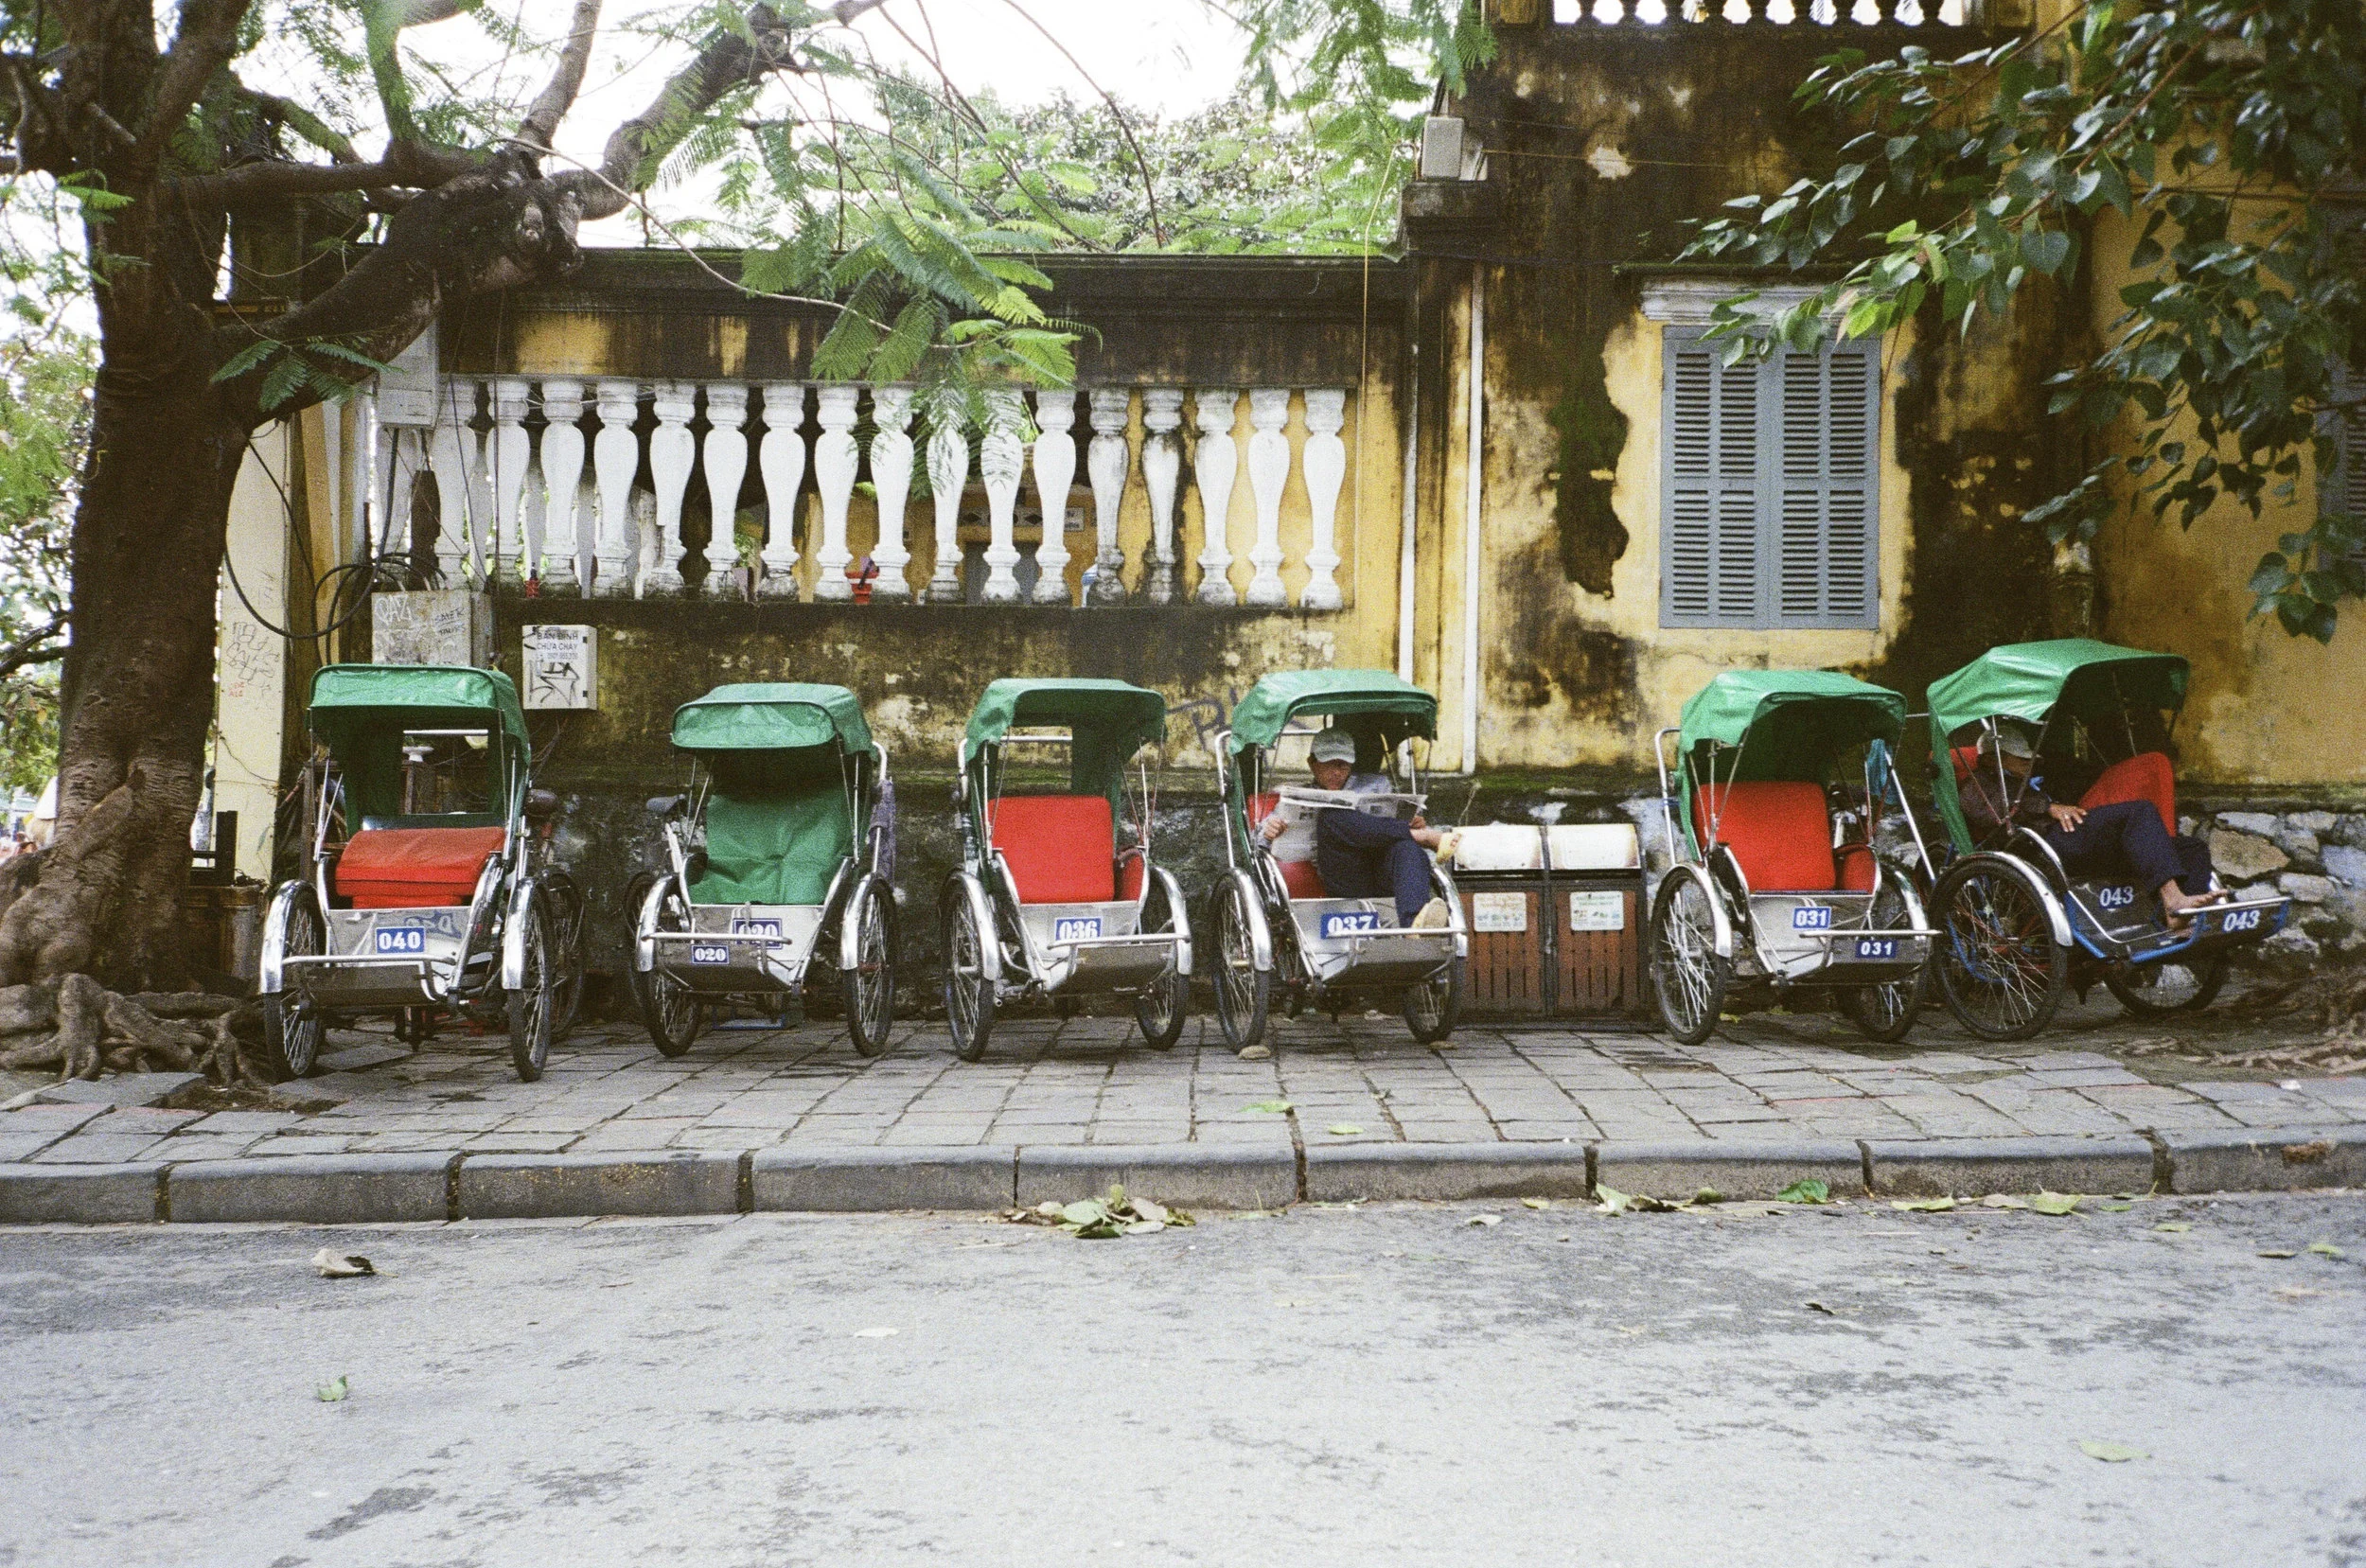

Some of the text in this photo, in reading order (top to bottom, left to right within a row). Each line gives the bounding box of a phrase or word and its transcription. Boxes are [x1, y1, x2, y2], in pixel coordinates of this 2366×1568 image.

[2099, 886, 2134, 907] 043
[1327, 915, 1373, 934] 037
[1795, 909, 1827, 926] 031
[2224, 909, 2260, 932] 043
[379, 931, 421, 950] 040
[1059, 921, 1099, 941] 036
[694, 947, 727, 961] 020
[1861, 942, 1893, 956] 031
